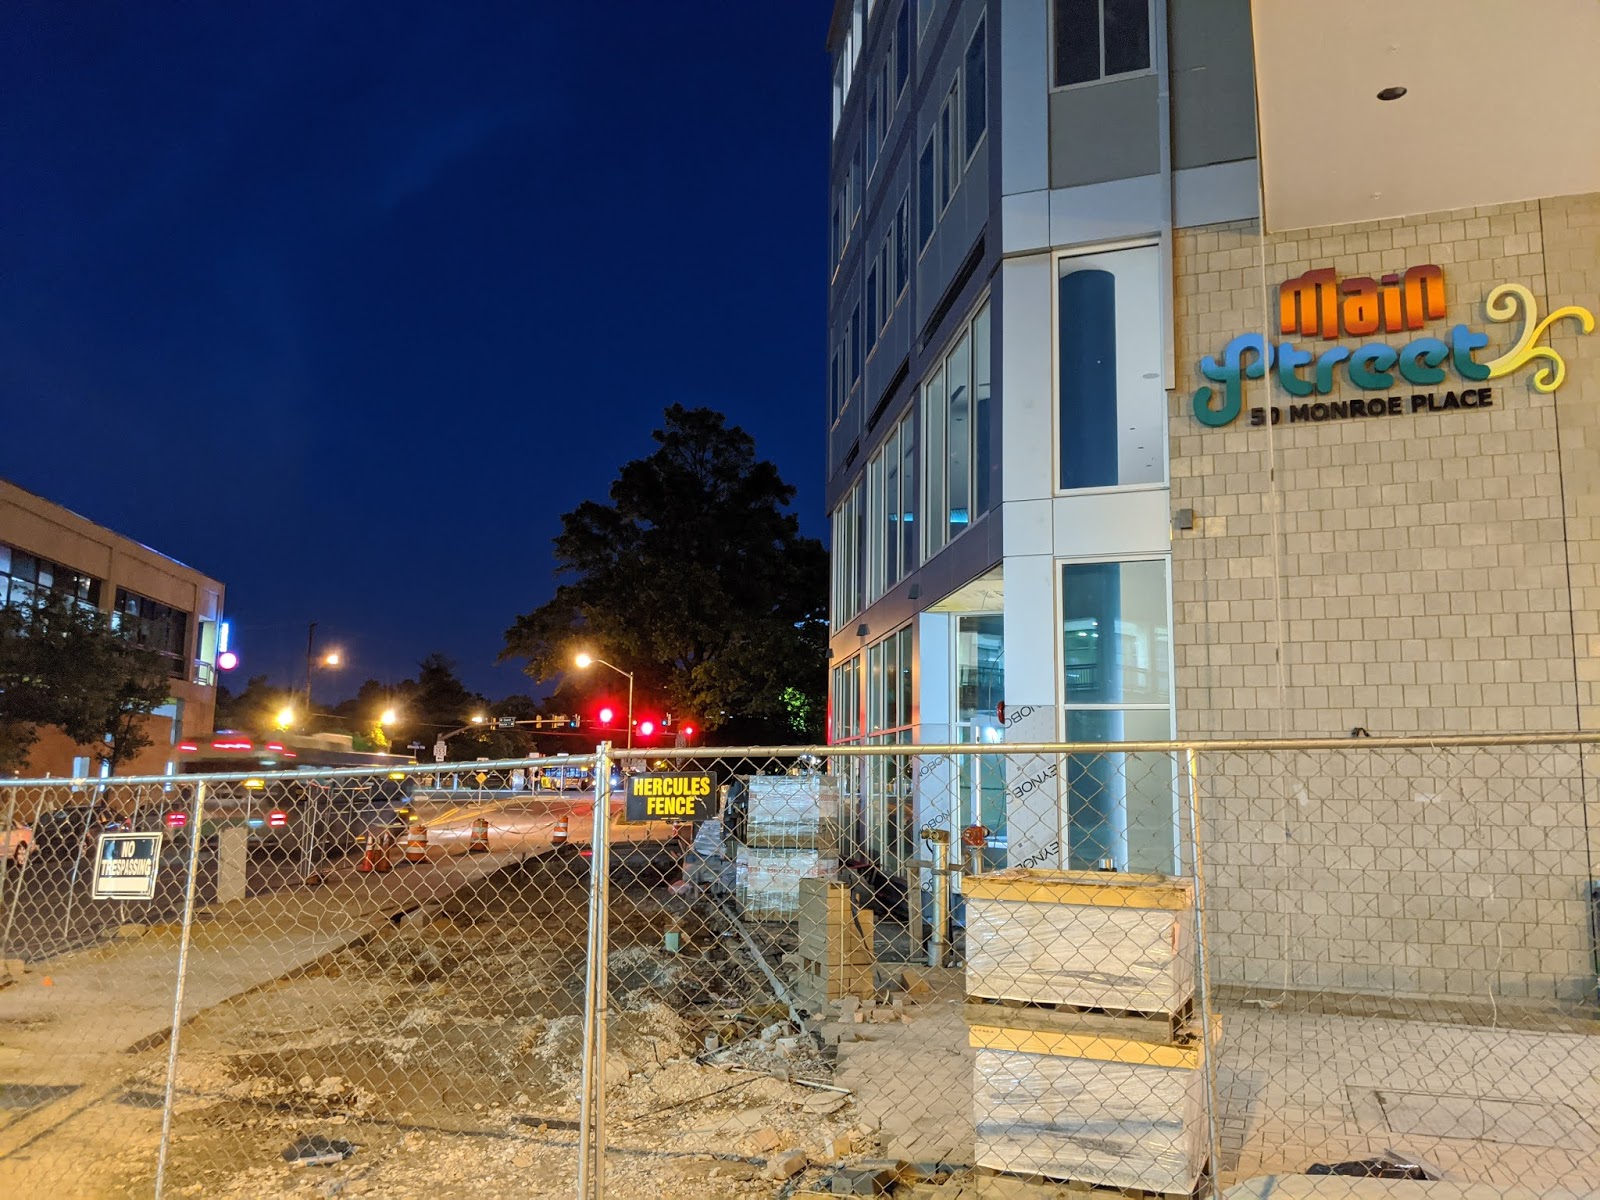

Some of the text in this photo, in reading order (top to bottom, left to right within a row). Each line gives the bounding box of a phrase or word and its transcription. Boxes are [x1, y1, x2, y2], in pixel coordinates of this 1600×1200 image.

[1280, 264, 1445, 340] Main
[1193, 323, 1491, 427] Street
[1250, 387, 1493, 426] 50 MONROE PLACE
[633, 777, 710, 796] HERCULES
[647, 796, 695, 815] FENCE
[120, 841, 136, 858] NO
[101, 859, 152, 876] TRESPASSING
